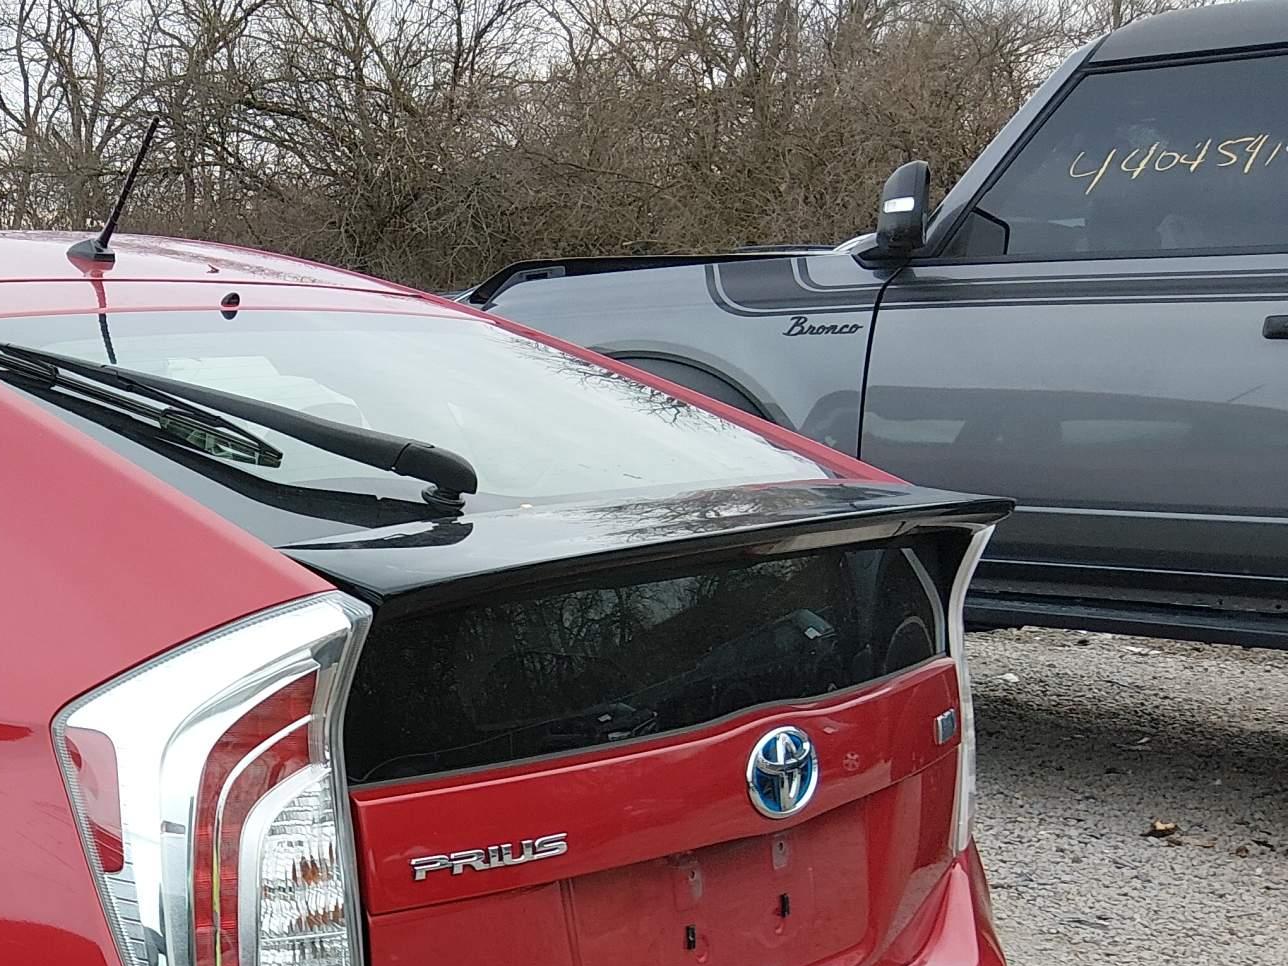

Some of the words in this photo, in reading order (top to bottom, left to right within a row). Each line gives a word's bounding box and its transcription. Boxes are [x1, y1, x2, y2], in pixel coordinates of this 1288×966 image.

[1069, 134, 1288, 195] 4404541
[782, 315, 864, 337] Bronco
[410, 832, 568, 881] PRIUS
